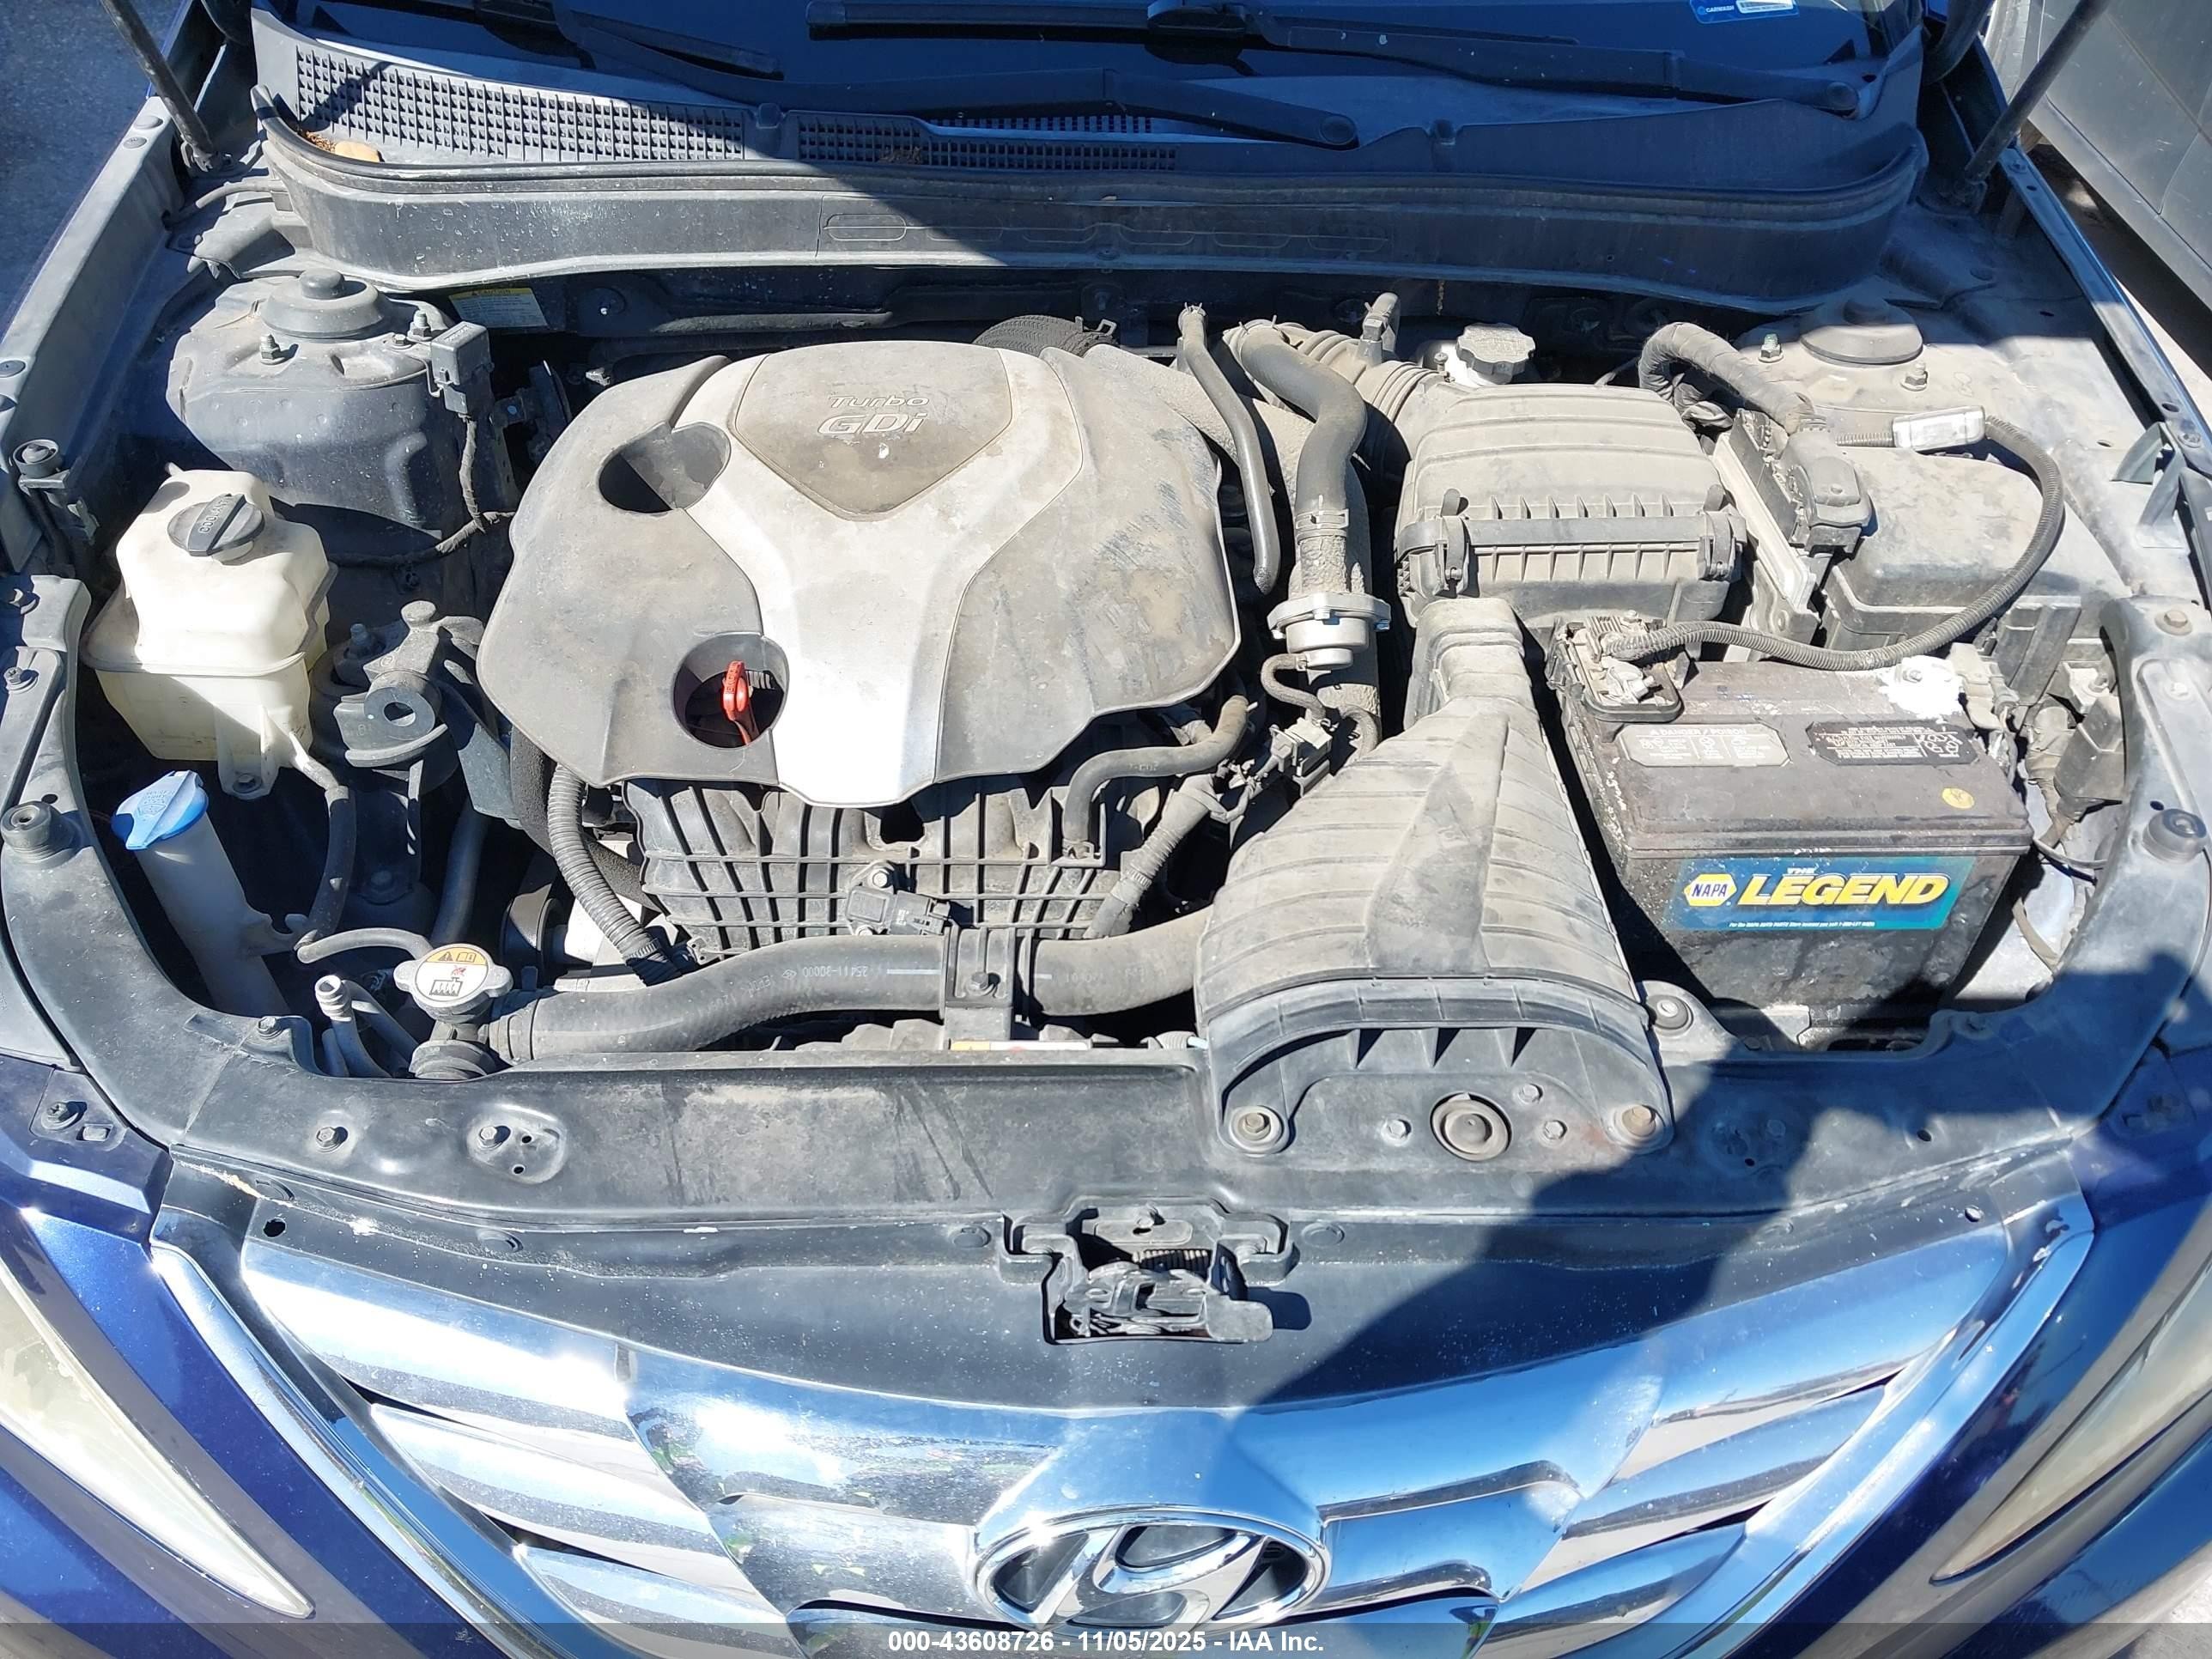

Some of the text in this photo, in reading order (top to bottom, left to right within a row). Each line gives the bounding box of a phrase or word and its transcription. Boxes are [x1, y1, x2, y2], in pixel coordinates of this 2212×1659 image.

[829, 395, 930, 408] Turbo
[817, 412, 928, 434] GDi
[1691, 883, 1728, 897] NAPA
[1738, 873, 1950, 906] LEGEND
